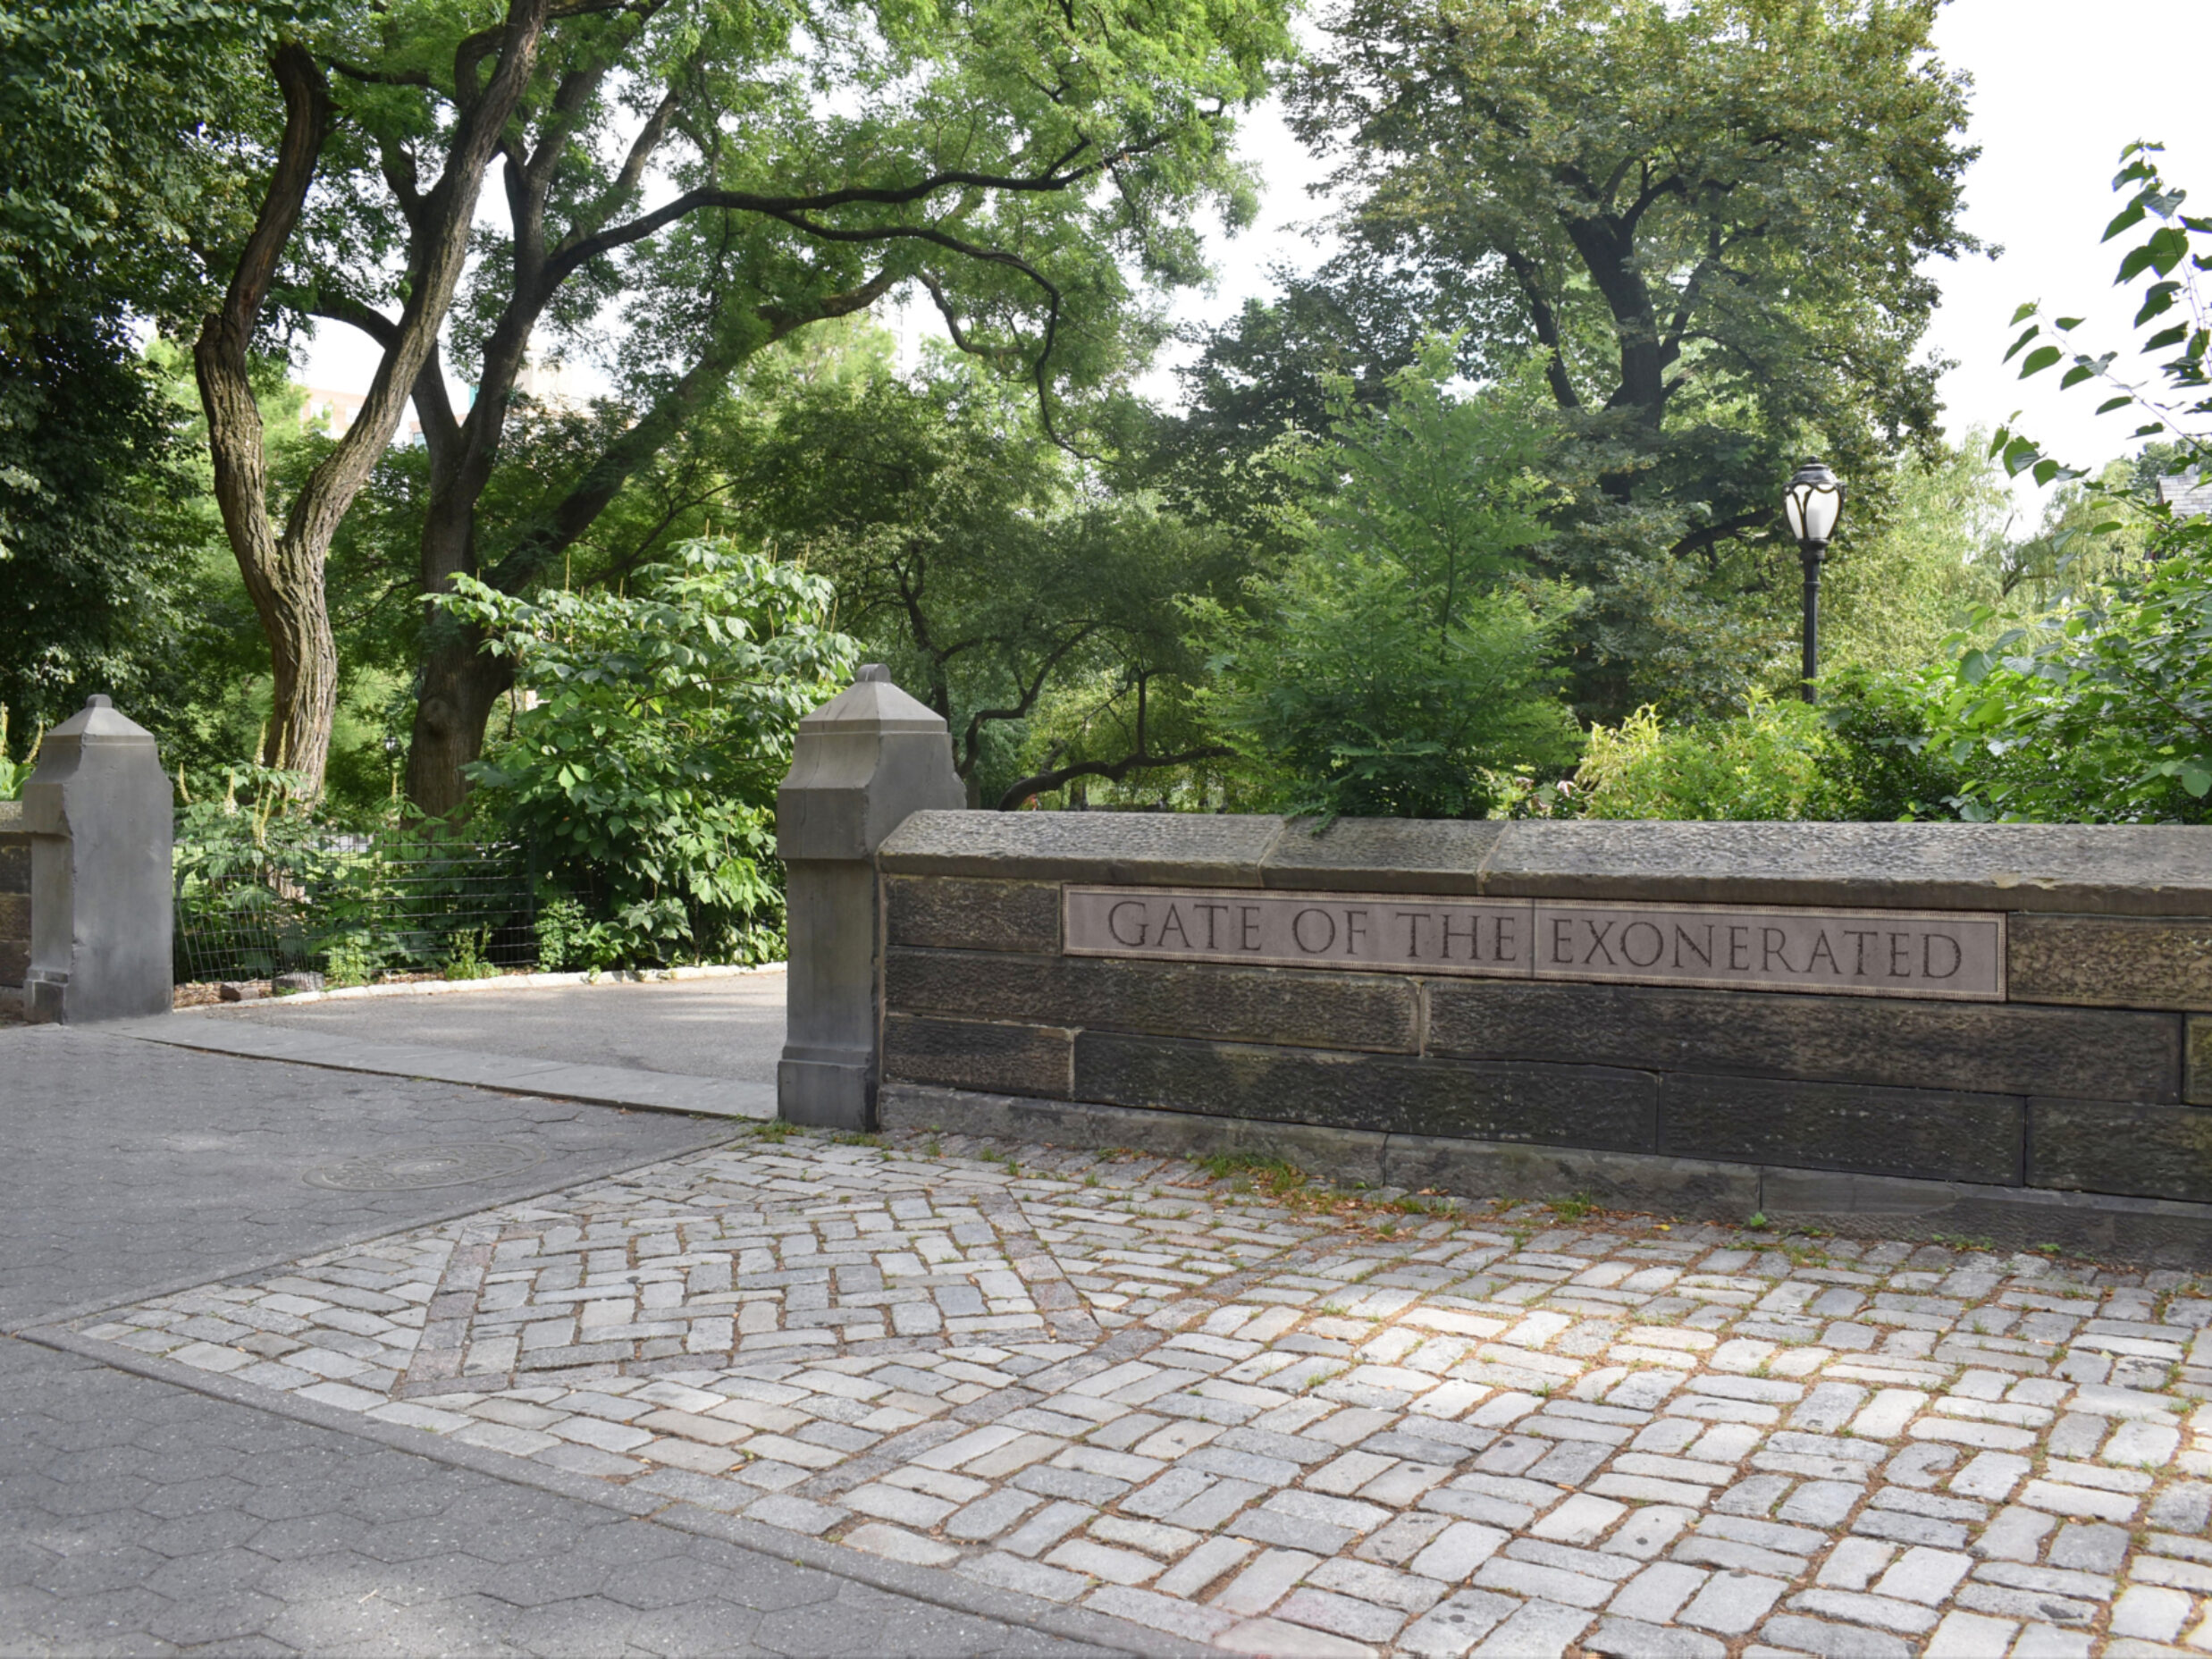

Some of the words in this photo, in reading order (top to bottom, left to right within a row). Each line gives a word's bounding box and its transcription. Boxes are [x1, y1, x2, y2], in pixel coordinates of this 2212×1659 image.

[1107, 901, 1261, 951] GATE
[1291, 908, 1367, 955] OF
[1396, 911, 1518, 962] THE
[1549, 918, 1962, 979] EXONERATED
